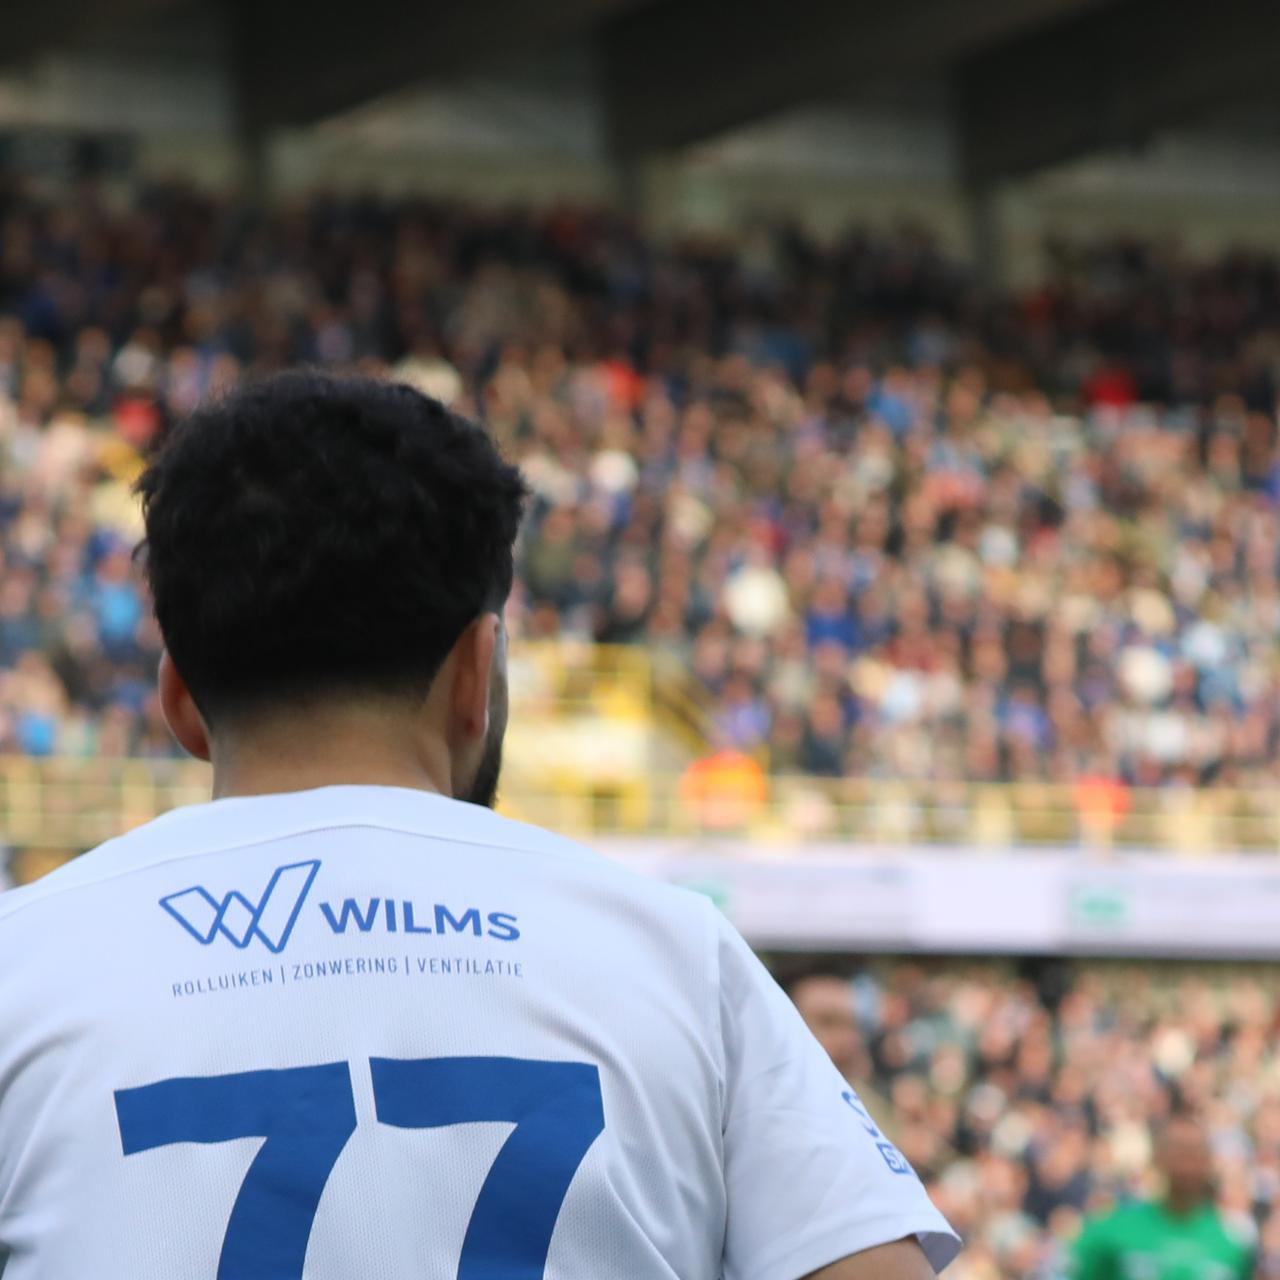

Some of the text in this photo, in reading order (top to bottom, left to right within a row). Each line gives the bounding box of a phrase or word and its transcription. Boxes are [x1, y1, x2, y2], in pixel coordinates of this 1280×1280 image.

[319, 898, 520, 942] WILMS
[172, 956, 524, 998] ROLLUIKEN ZONWERING VENTILATIE
